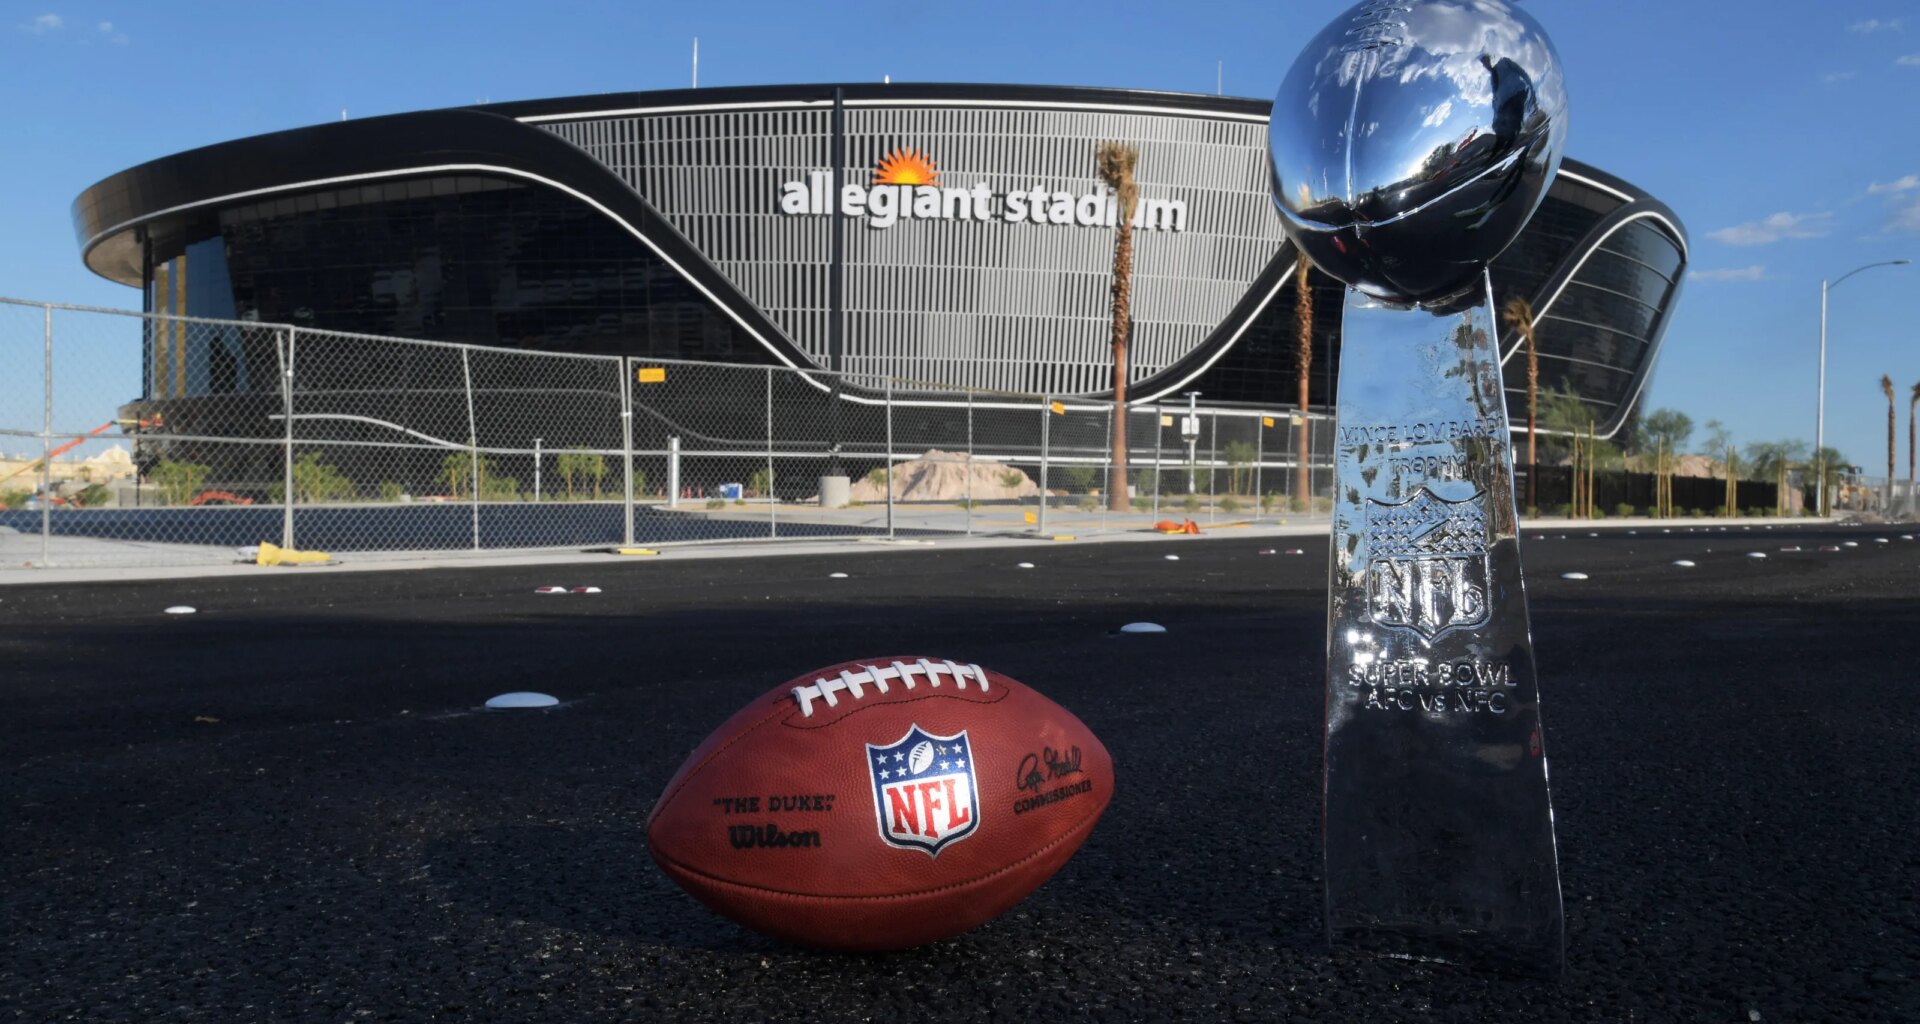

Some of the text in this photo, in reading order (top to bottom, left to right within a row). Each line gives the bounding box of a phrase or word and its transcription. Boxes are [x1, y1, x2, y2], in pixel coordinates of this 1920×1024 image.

[781, 170, 991, 228] allegiant
[1340, 425, 1398, 443] VINCE
[1387, 455, 1466, 475] TROPHY
[1349, 660, 1518, 687] SUPER BOWL
[1364, 688, 1414, 711] AFC
[1453, 687, 1506, 714] NFC
[886, 778, 970, 840] NFL
[1013, 779, 1093, 816] COMMISSIONER
[728, 823, 822, 850] Wilson
